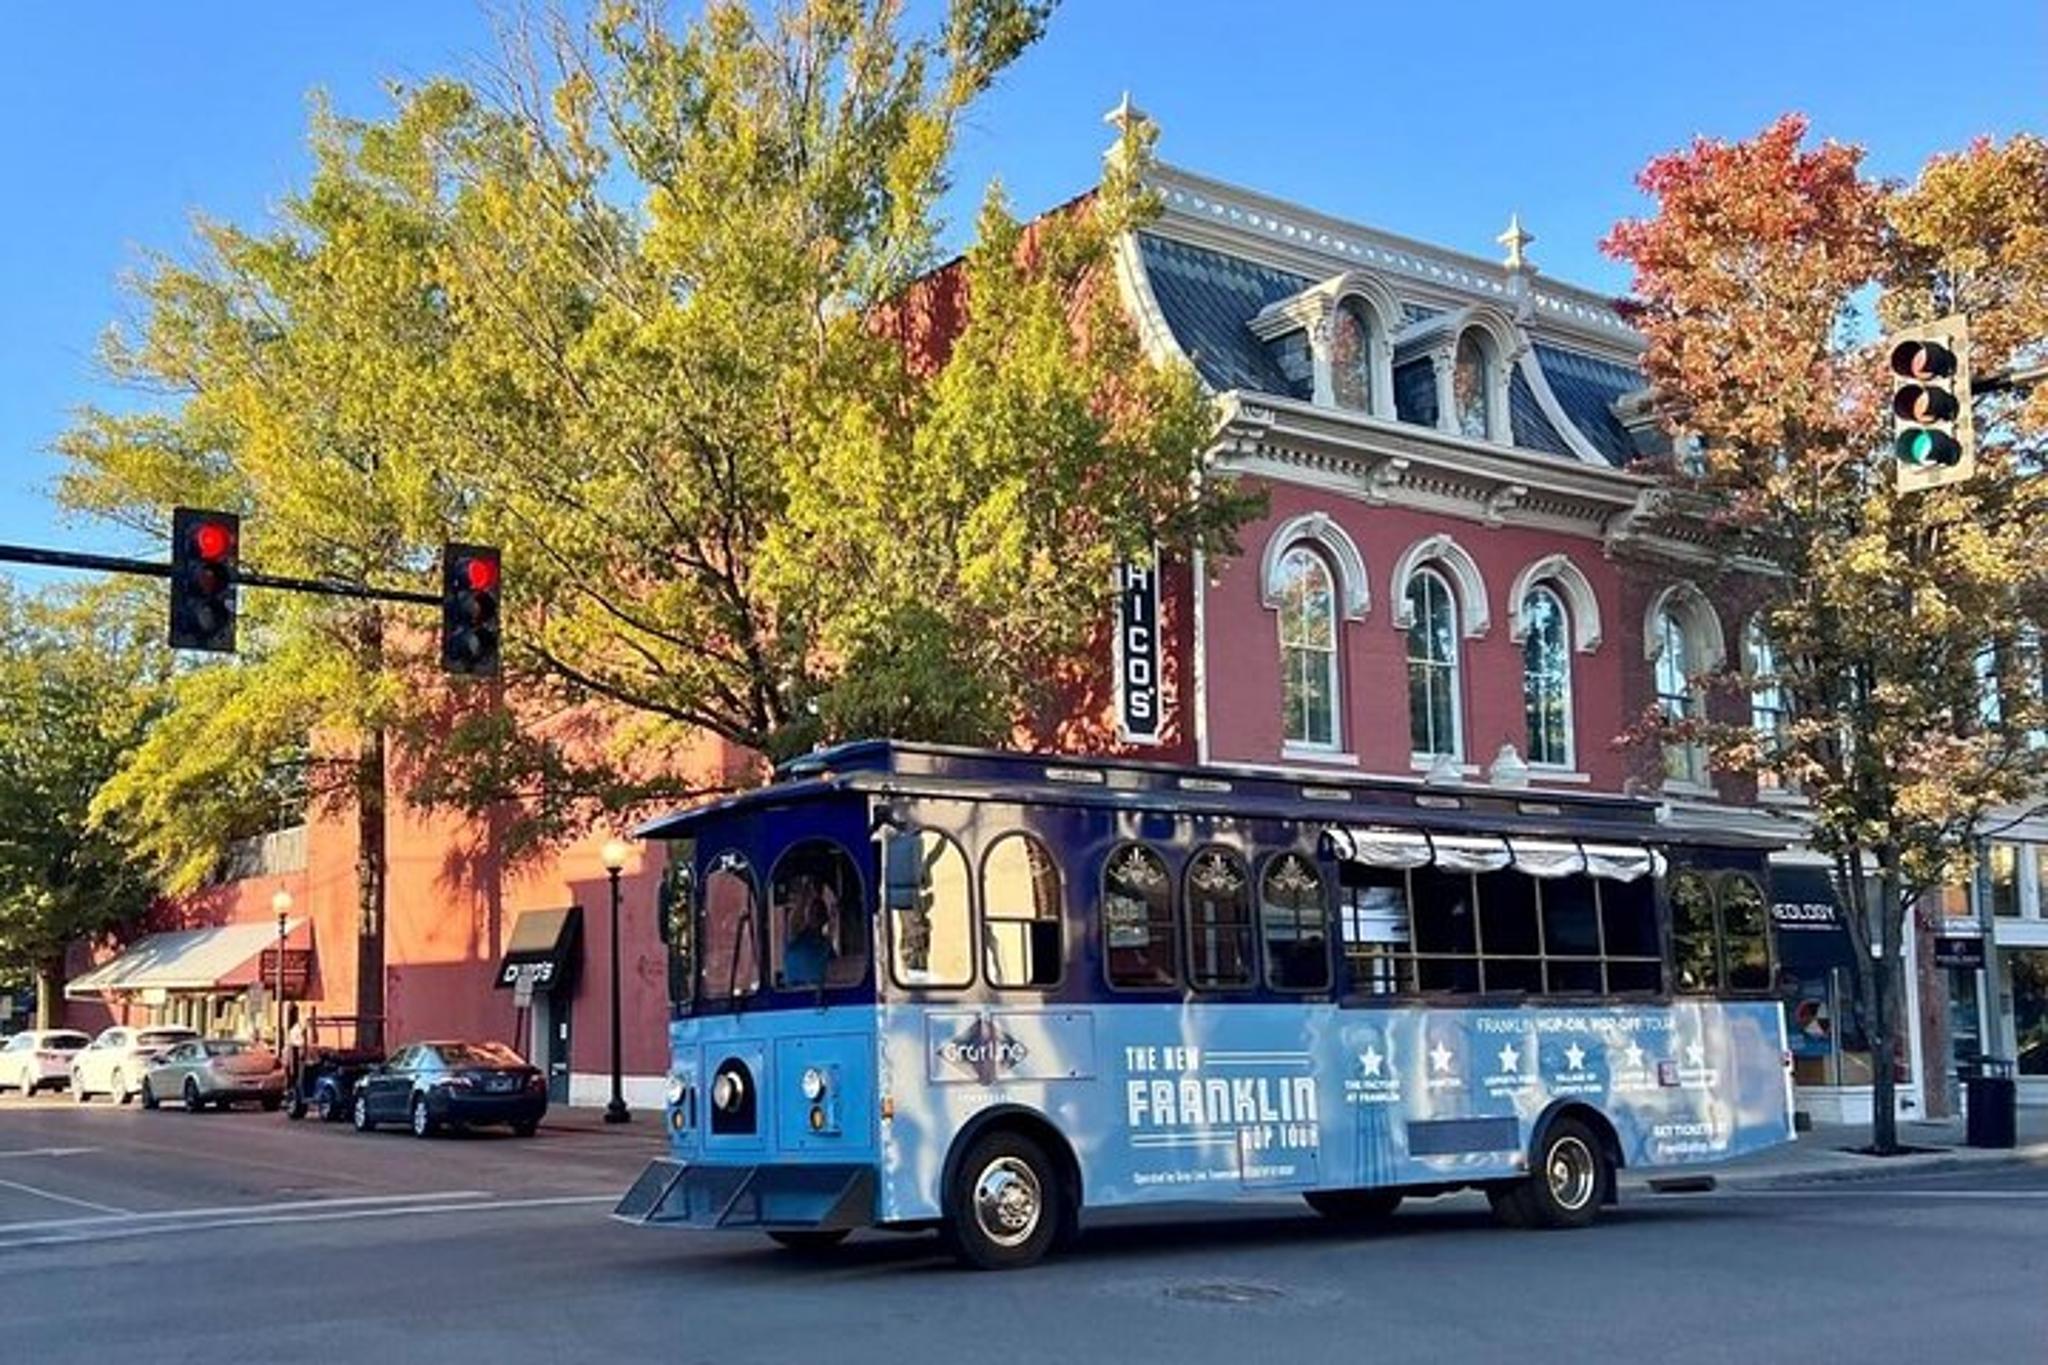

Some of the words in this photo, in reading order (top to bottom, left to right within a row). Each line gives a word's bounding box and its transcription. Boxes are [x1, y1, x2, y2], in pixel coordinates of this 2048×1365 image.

[1127, 562, 1155, 718] HICO'S
[1126, 1046, 1156, 1071] THE
[1163, 1046, 1199, 1071] NEW
[1127, 1077, 1318, 1127] FRANKLIN
[1242, 1125, 1273, 1150] HOP
[1279, 1123, 1320, 1148] TOUR
